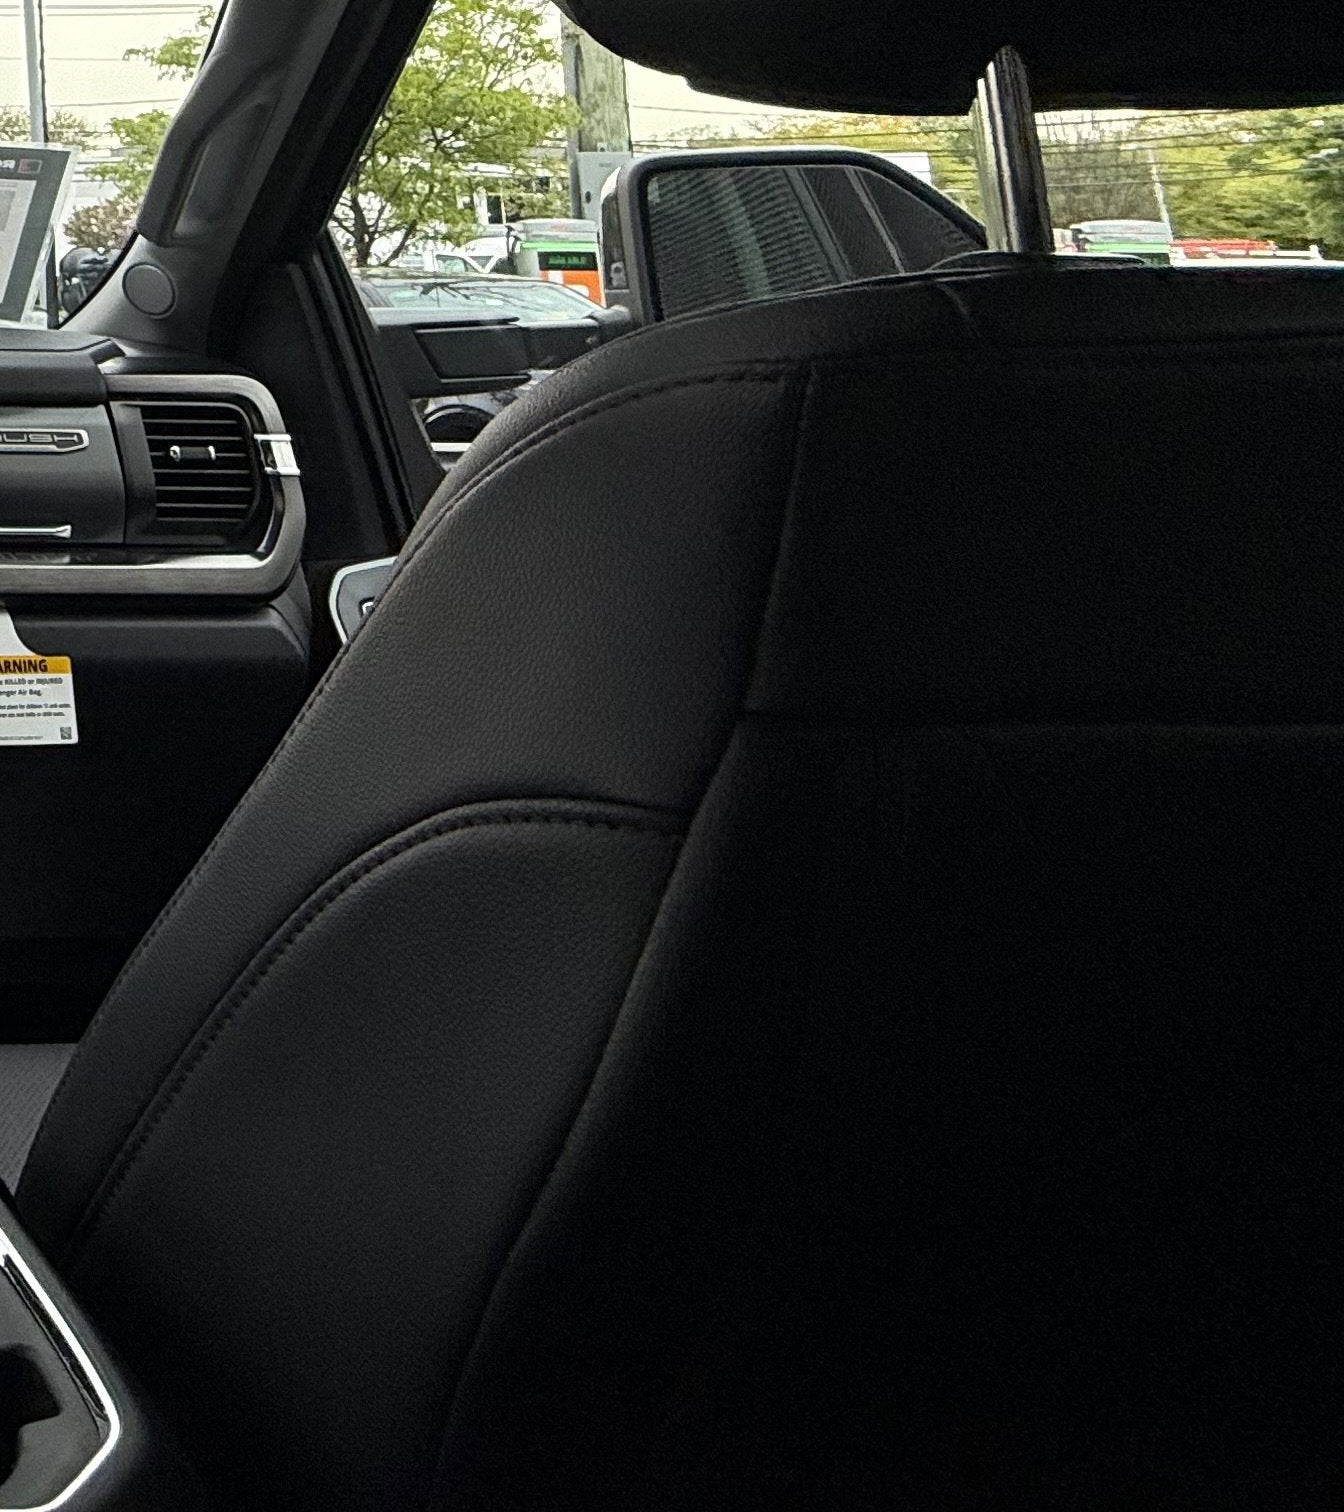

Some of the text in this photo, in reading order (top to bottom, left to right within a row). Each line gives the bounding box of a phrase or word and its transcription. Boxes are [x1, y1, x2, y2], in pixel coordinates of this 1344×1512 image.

[4, 677, 27, 685] KILLED
[36, 677, 63, 685] INJURED
[18, 688, 28, 696] Air
